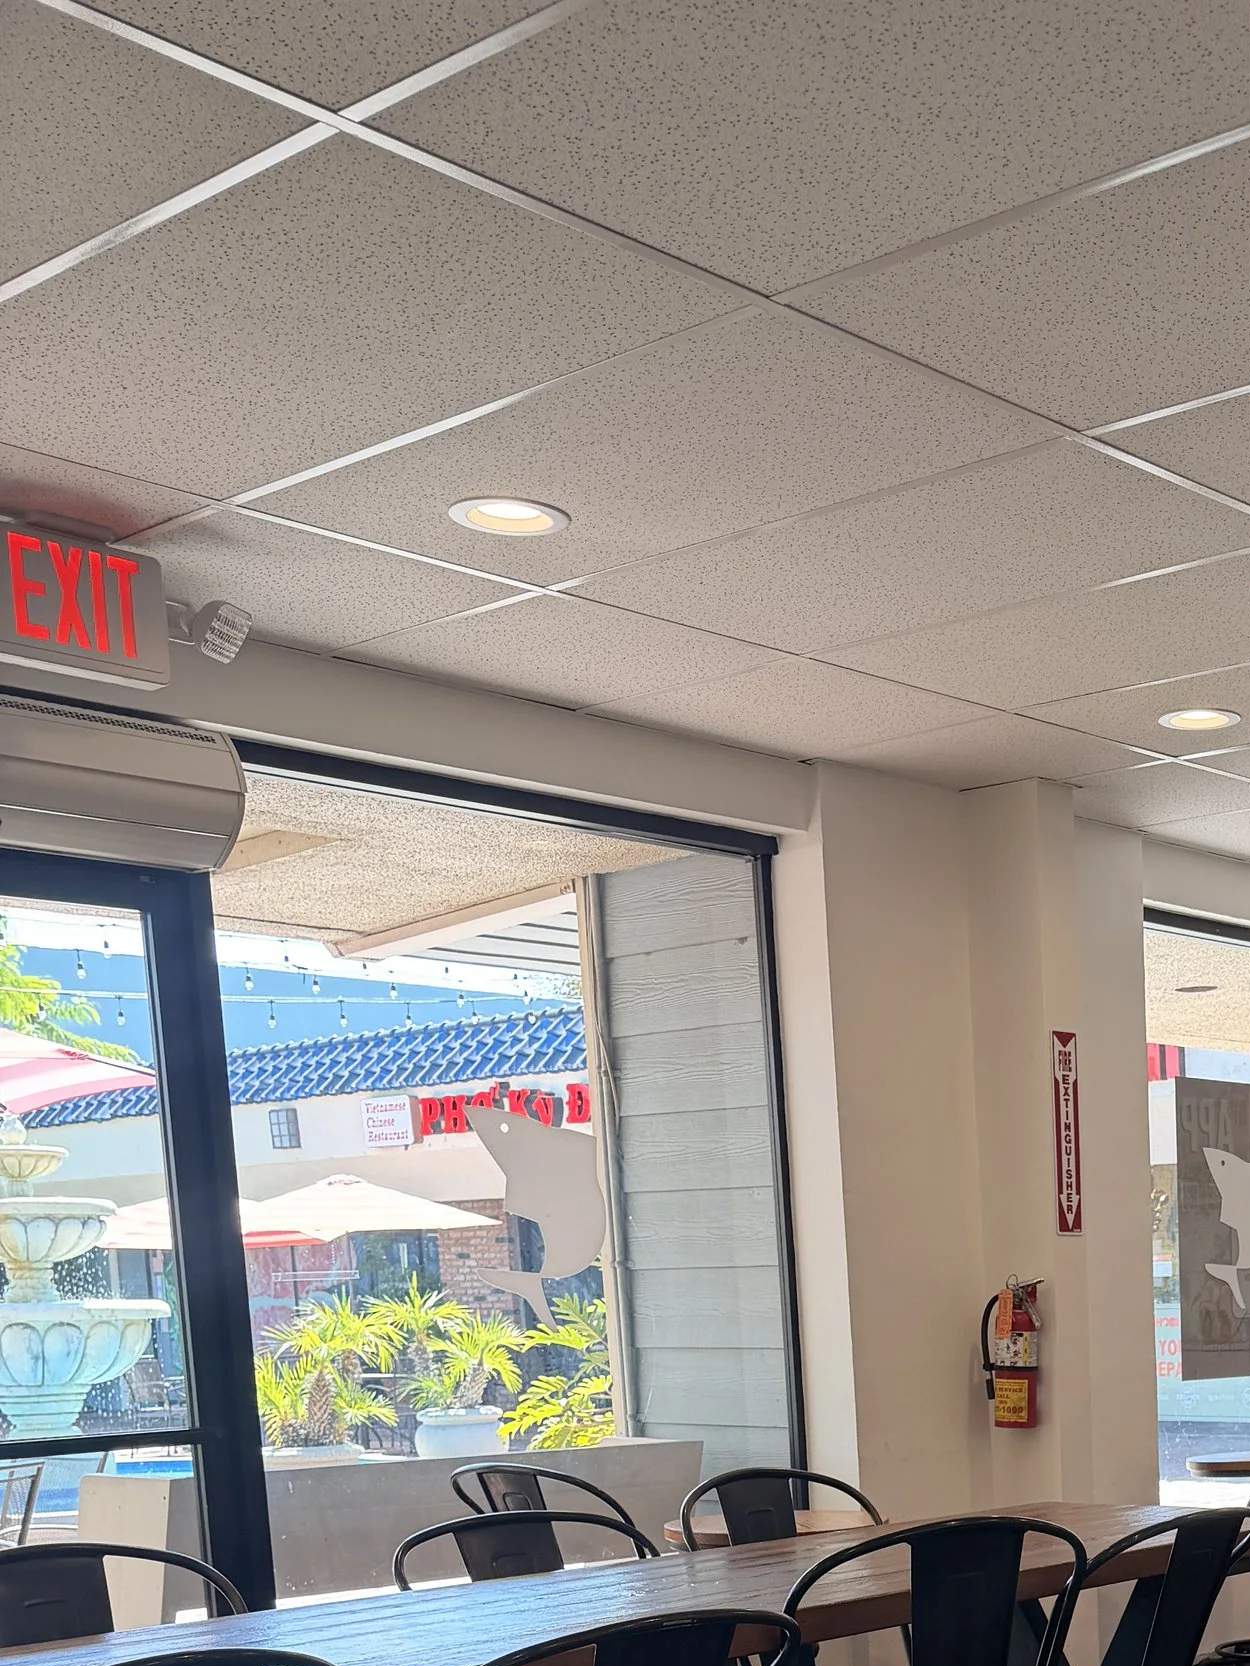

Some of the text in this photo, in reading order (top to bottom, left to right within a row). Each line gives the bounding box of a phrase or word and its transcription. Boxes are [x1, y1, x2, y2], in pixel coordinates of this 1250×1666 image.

[7, 532, 139, 659] EXIT
[365, 1102, 406, 1114] Vietnamese
[366, 1117, 395, 1128] Chinese
[368, 1129, 409, 1142] Restaurant
[1061, 1074, 1074, 1214] EXTINGUISHER
